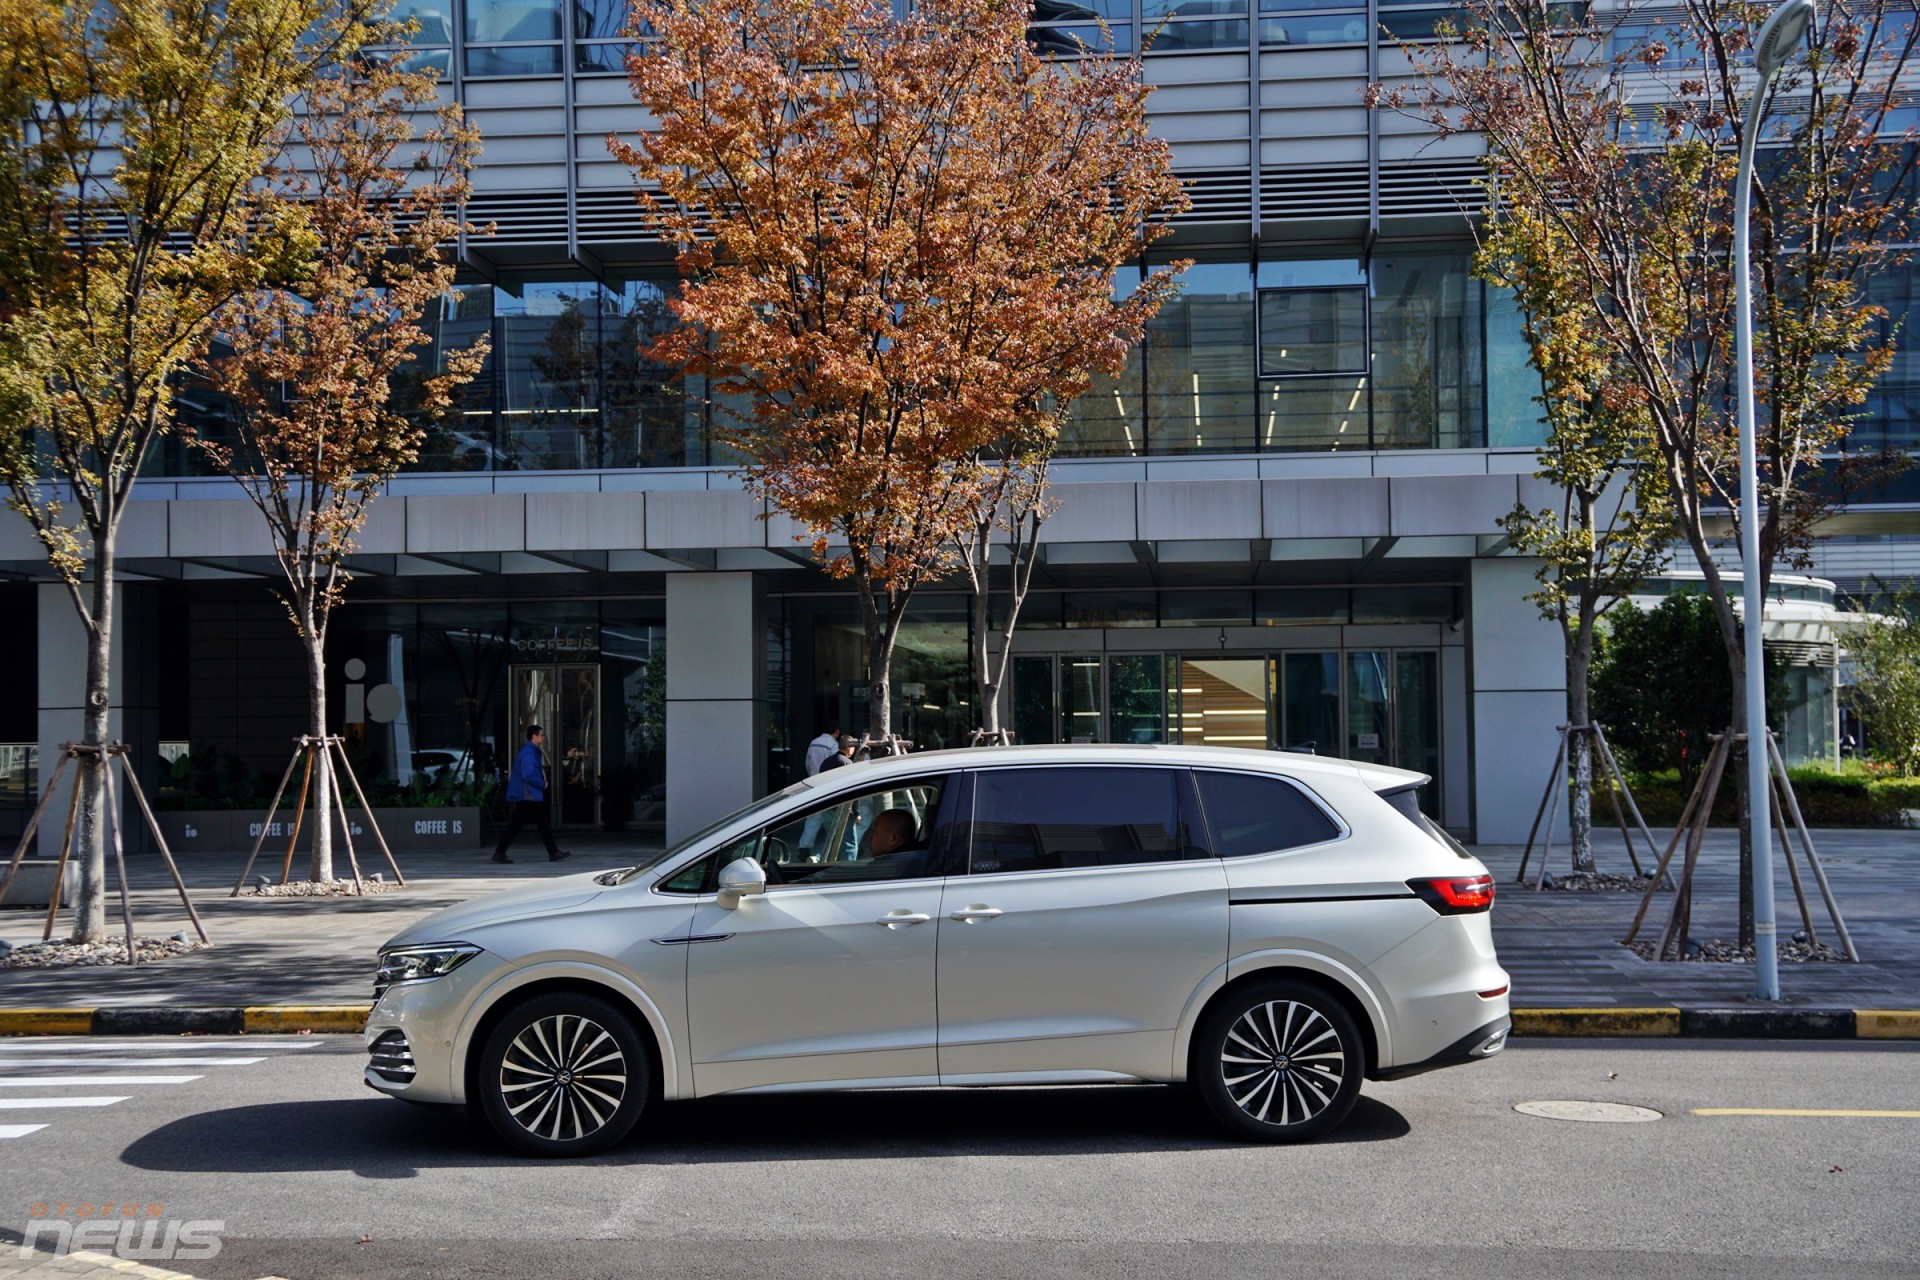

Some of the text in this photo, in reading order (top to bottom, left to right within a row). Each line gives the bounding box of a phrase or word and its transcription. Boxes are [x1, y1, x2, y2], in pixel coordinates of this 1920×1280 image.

[517, 638, 576, 651] COFFEE
[249, 822, 282, 837] COFEE
[414, 820, 462, 834] COFFEE IS
